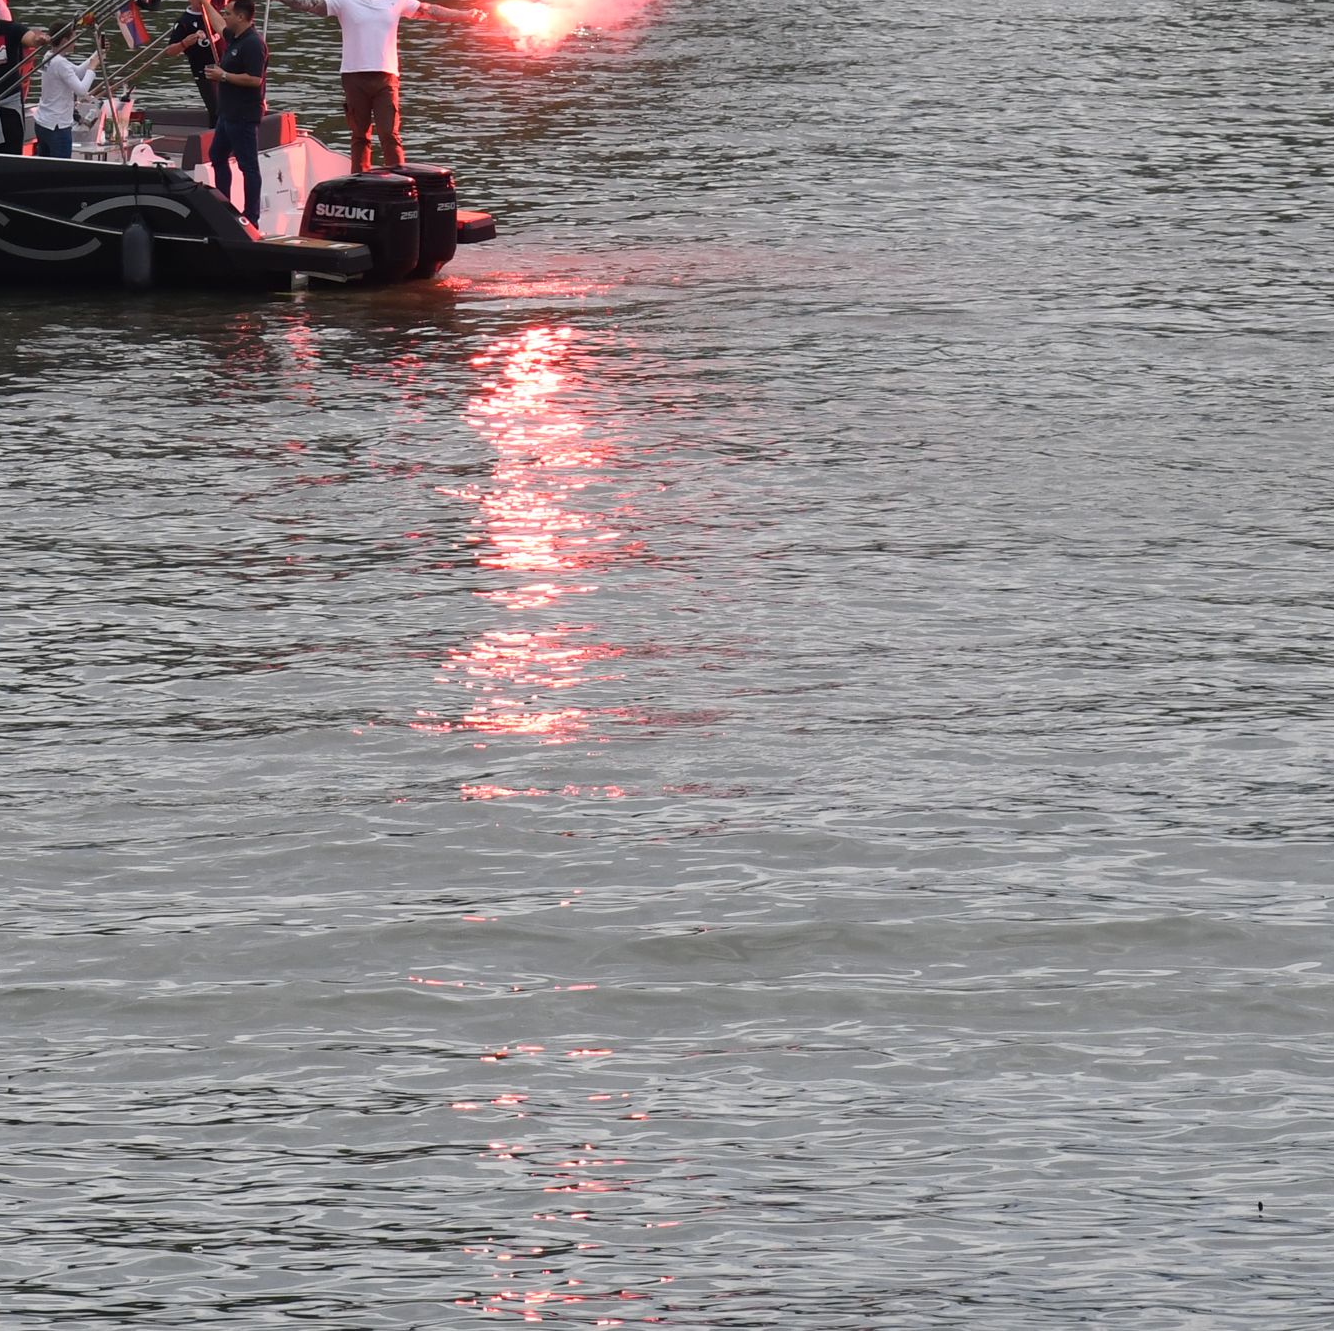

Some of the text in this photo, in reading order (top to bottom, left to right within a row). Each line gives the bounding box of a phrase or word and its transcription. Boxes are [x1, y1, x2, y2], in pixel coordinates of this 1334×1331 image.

[315, 203, 375, 221] SUZUKI
[436, 201, 456, 212] 250
[400, 210, 418, 220] 250
